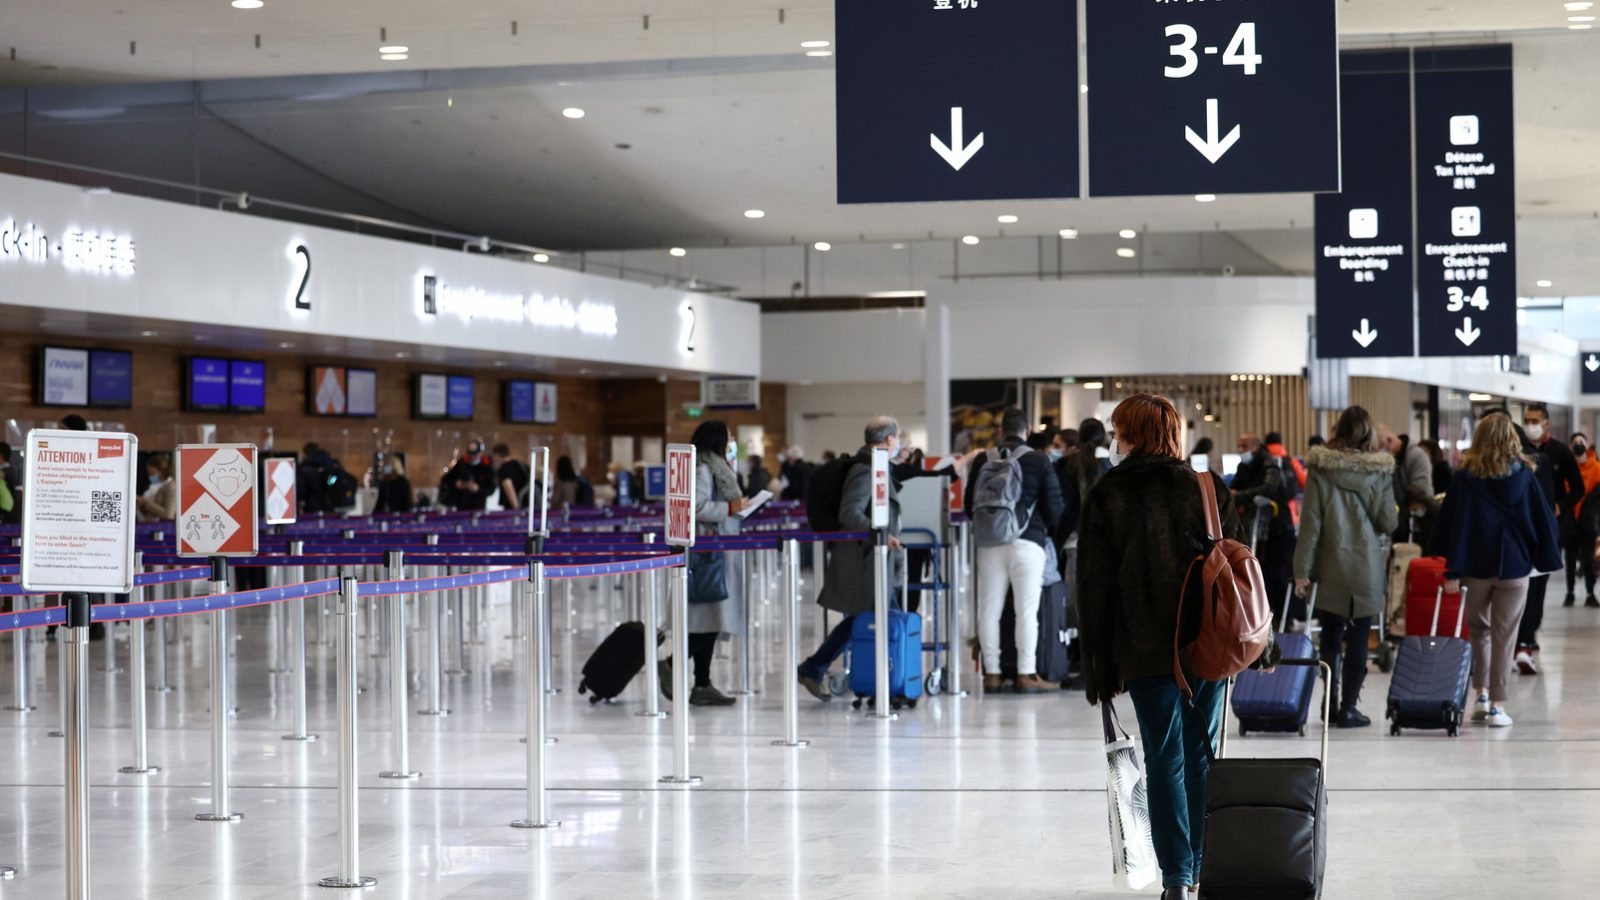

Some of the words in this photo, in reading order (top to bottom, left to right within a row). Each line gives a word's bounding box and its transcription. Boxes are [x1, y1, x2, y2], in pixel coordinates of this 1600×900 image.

[1164, 22, 1262, 78] 3-4
[1435, 165, 1453, 176] Tax
[1455, 163, 1494, 175] Refund
[1324, 244, 1403, 257] Embarquement
[1425, 242, 1507, 256] Enregistrement
[1340, 258, 1388, 270] Boarding
[1443, 256, 1490, 267] Check-in
[296, 245, 310, 310] 2
[1447, 286, 1489, 311] 3-4
[38, 451, 86, 463] ATTENTION
[89, 453, 92, 464] !
[670, 452, 691, 495] EXIT
